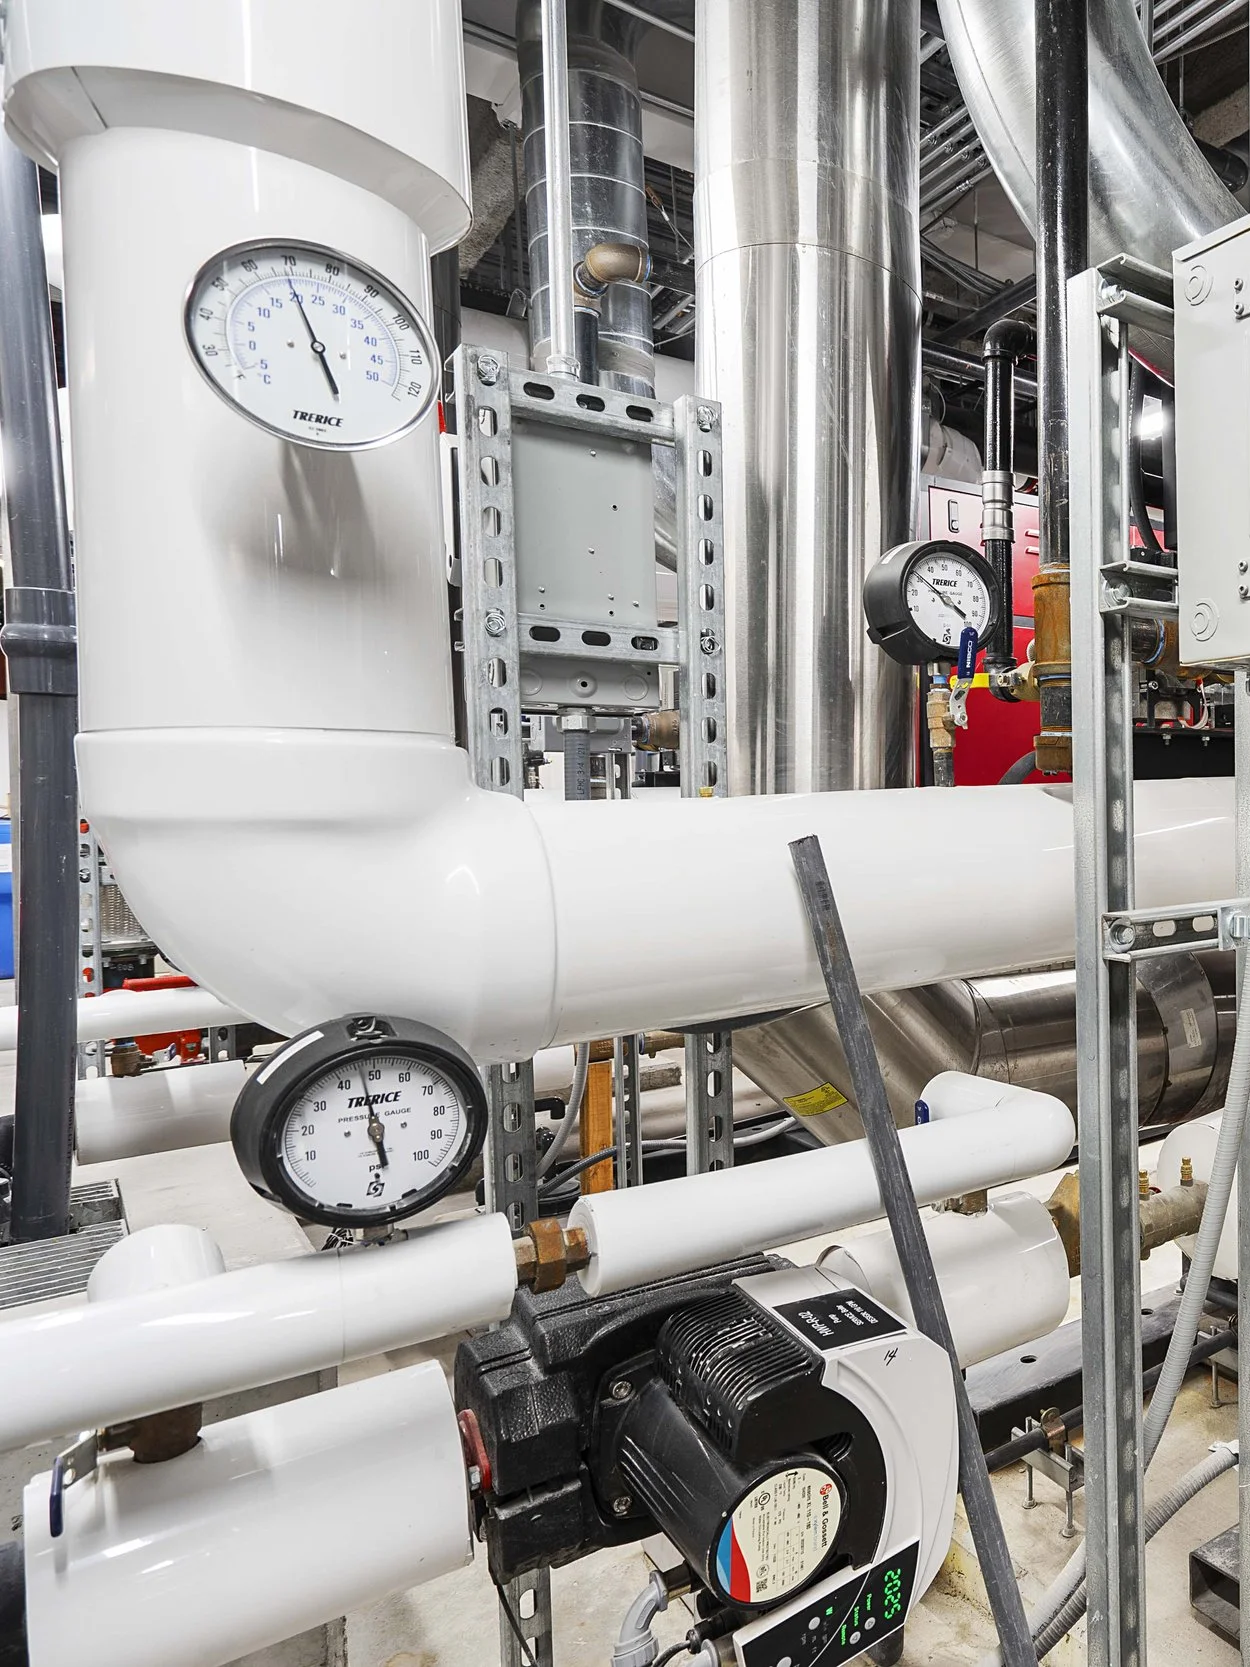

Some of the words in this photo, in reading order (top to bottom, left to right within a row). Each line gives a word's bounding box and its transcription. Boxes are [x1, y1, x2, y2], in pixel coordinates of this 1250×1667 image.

[241, 259, 259, 273] 60
[281, 255, 297, 267] 70
[325, 263, 341, 277] 80
[211, 276, 230, 292] 50
[364, 284, 380, 299] 90
[270, 297, 283, 309] 15
[289, 292, 304, 305] 20
[311, 294, 326, 306] 25
[198, 307, 215, 321] 40
[257, 307, 271, 319] 10
[332, 304, 346, 316] 30
[247, 321, 255, 332] 5
[350, 318, 365, 330] 35
[391, 314, 410, 331] 100
[248, 339, 257, 351] 0
[363, 336, 378, 347] 40
[201, 344, 218, 357] 30
[370, 354, 384, 365] 45
[408, 349, 423, 365] 110
[365, 370, 379, 382] 50
[407, 381, 422, 398] 120
[292, 409, 344, 427] TRERICE
[955, 569, 962, 577] 60
[932, 578, 958, 588] TRERICE
[911, 588, 918, 596] 20
[368, 1069, 382, 1081] 50
[398, 1071, 411, 1083] 60
[337, 1079, 351, 1091] 40
[421, 1084, 434, 1096] 70
[313, 1099, 327, 1112] 30
[347, 1090, 403, 1110] TRERICE
[337, 1111, 381, 1124] PRESSUE
[384, 1106, 412, 1117] GAUGE
[433, 1105, 446, 1117] 80
[301, 1123, 315, 1136] 20
[430, 1128, 443, 1140] 90
[305, 1150, 317, 1161] 10
[412, 1149, 430, 1162] 100
[369, 1164, 385, 1173] ps
[798, 1310, 834, 1337] HWP-R-02
[828, 1313, 842, 1324] Pump
[884, 1347, 899, 1367] 14
[821, 1494, 830, 1510] Bell
[821, 1518, 830, 1548] Gossett
[884, 1568, 901, 1620] 2025
[825, 1606, 834, 1616] W
